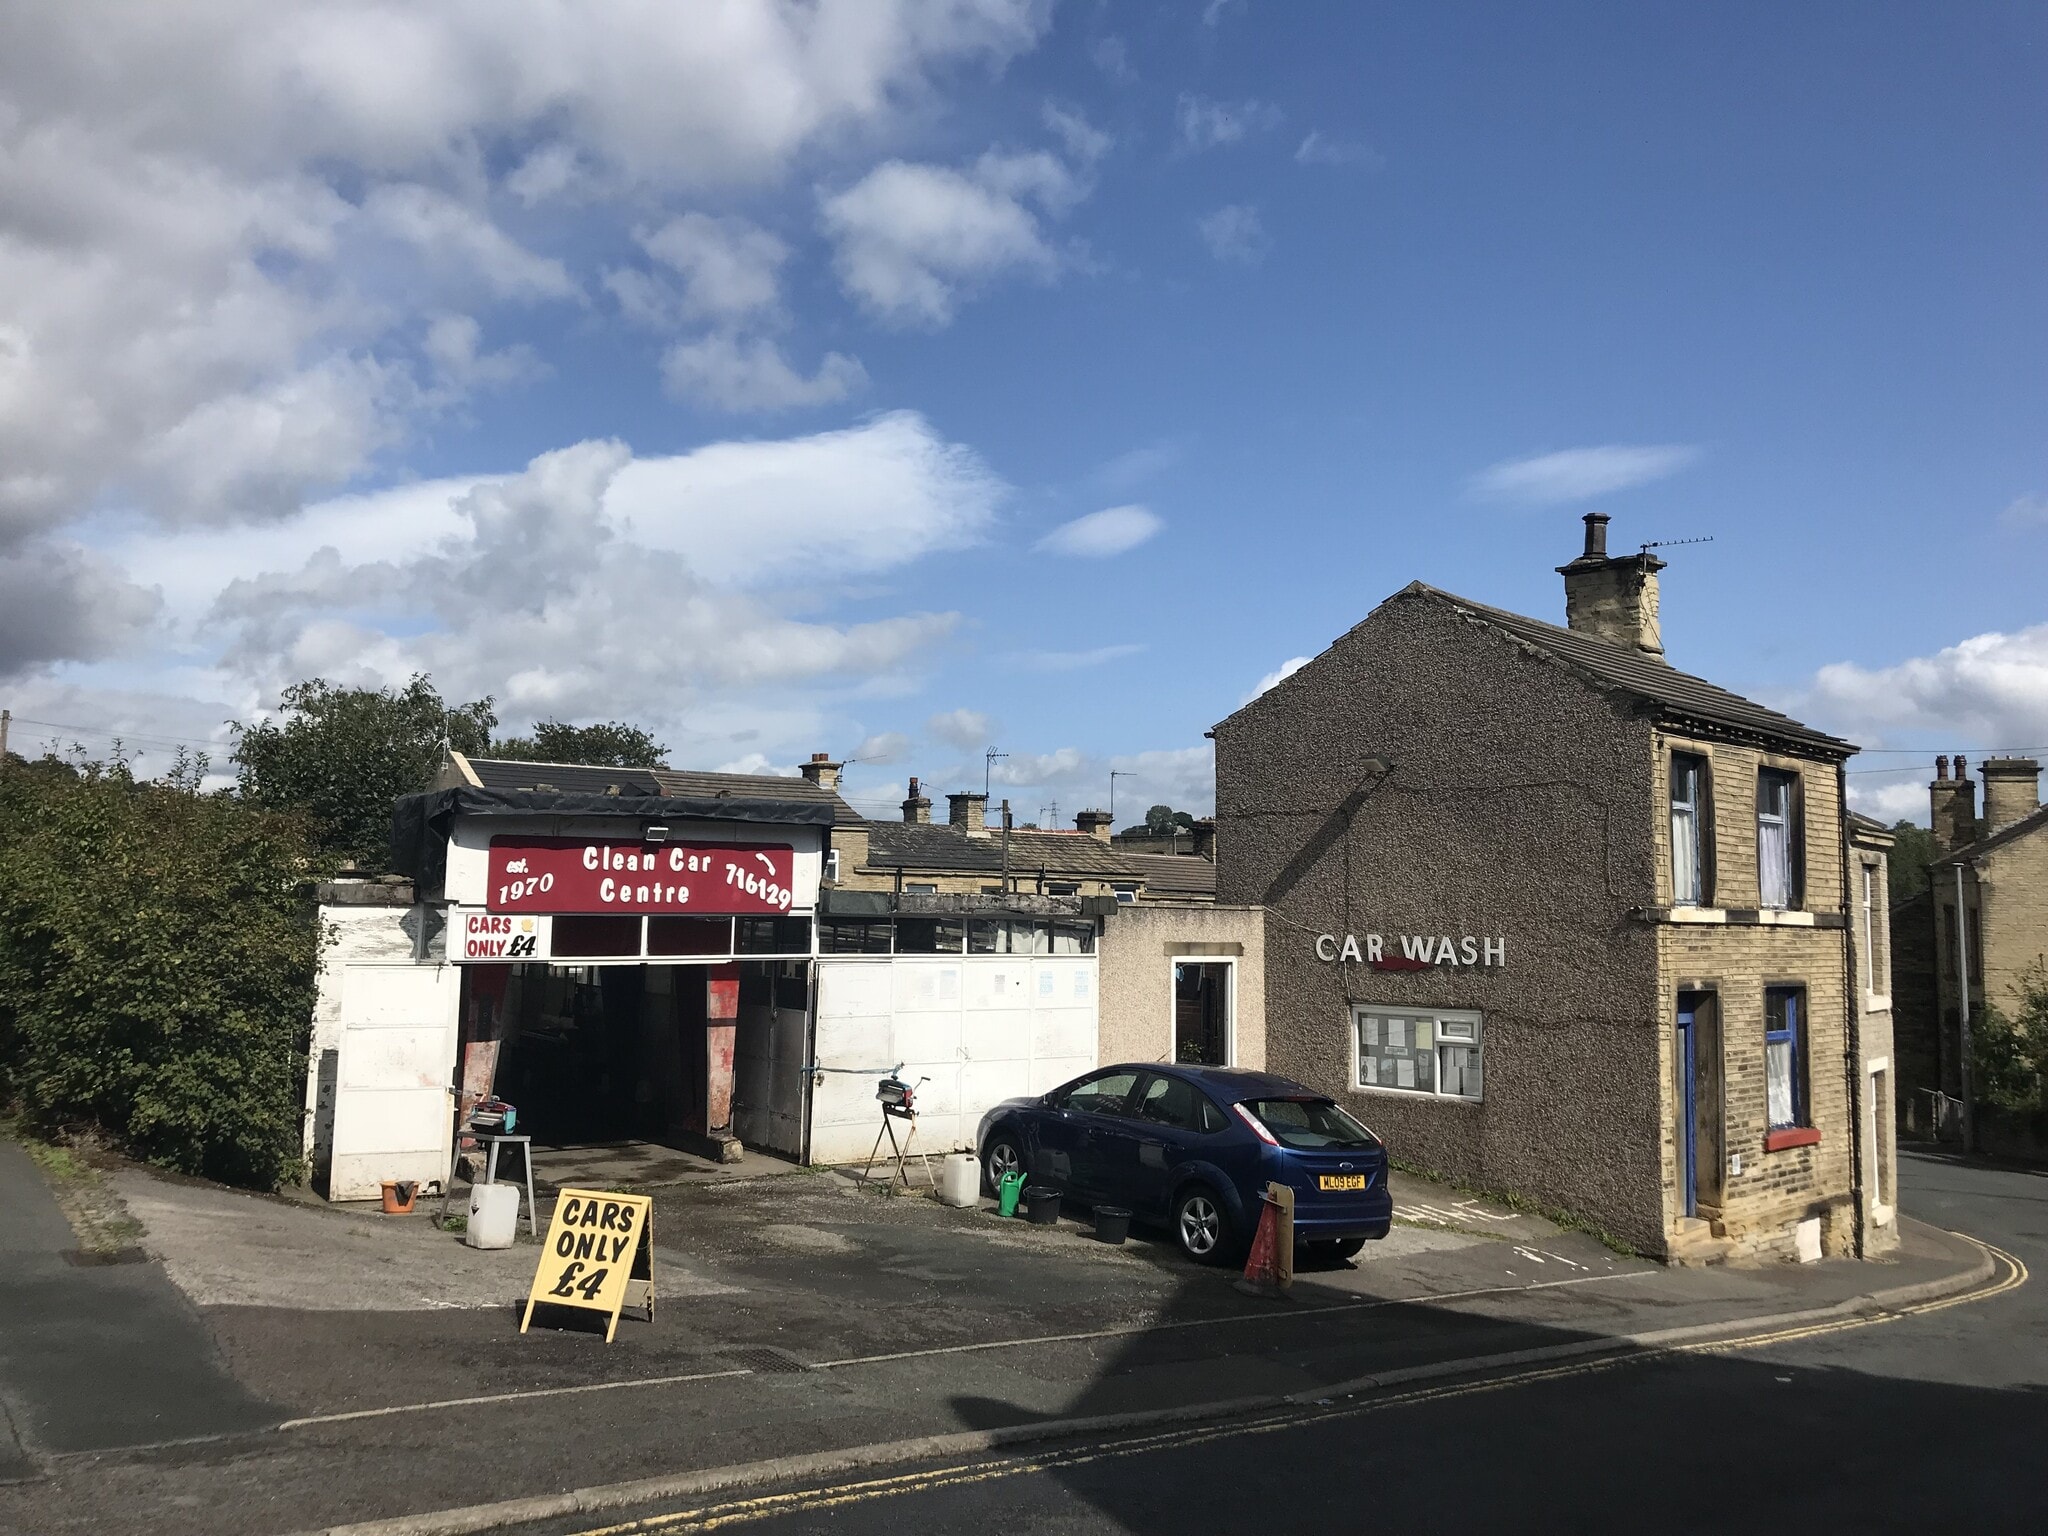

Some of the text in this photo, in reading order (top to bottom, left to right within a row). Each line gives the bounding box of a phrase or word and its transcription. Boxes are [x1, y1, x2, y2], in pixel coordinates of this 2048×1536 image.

[506, 857, 529, 874] est.
[582, 845, 711, 872] Clean Car
[499, 872, 554, 905] 1970
[600, 877, 690, 904] Centre
[725, 863, 792, 910] 716129
[468, 916, 512, 935] CARS
[467, 935, 537, 957] ONLY £4
[1315, 933, 1505, 967] CAR WASH
[1346, 1175, 1362, 1188] EGF
[562, 1199, 635, 1232] CARS
[556, 1230, 630, 1264] ONLY
[548, 1261, 609, 1301] £4
